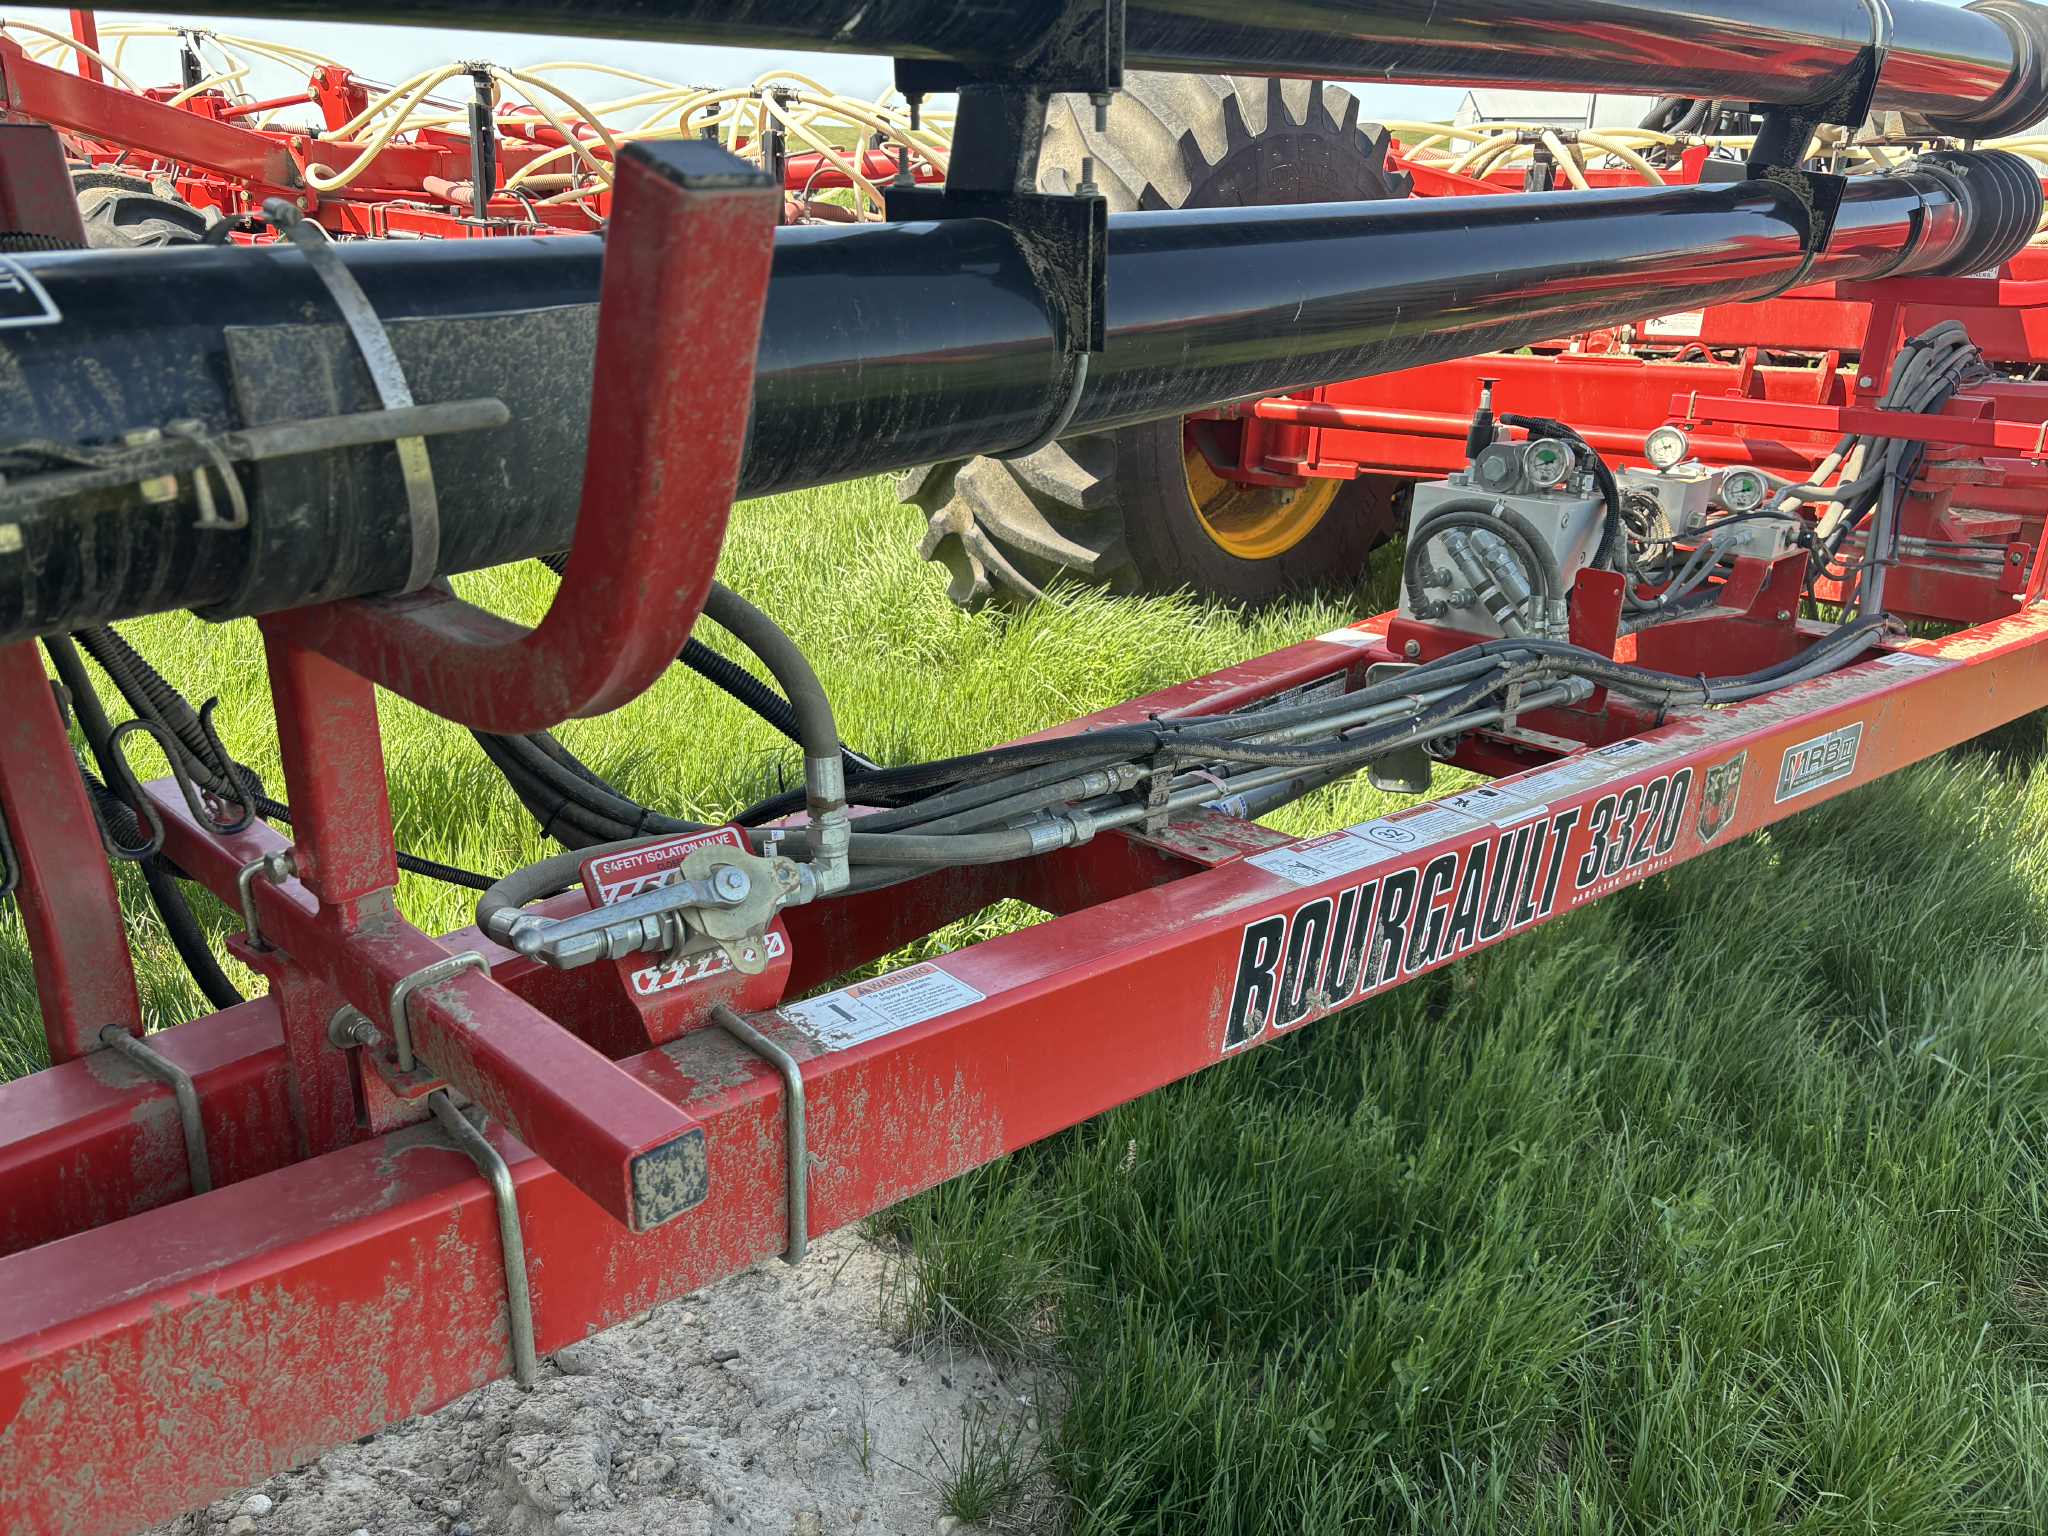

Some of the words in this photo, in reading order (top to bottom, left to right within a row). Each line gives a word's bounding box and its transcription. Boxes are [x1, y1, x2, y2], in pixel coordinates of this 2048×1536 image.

[1377, 828, 1405, 839] 32
[603, 854, 643, 874] SAFETY
[646, 841, 697, 863] ISOLATION
[698, 833, 731, 848] VALVE
[1648, 856, 1673, 871] DRILL
[1221, 806, 1581, 1054] BOURGAULT
[1574, 766, 1694, 889] 3320
[868, 966, 929, 991] WARNING
